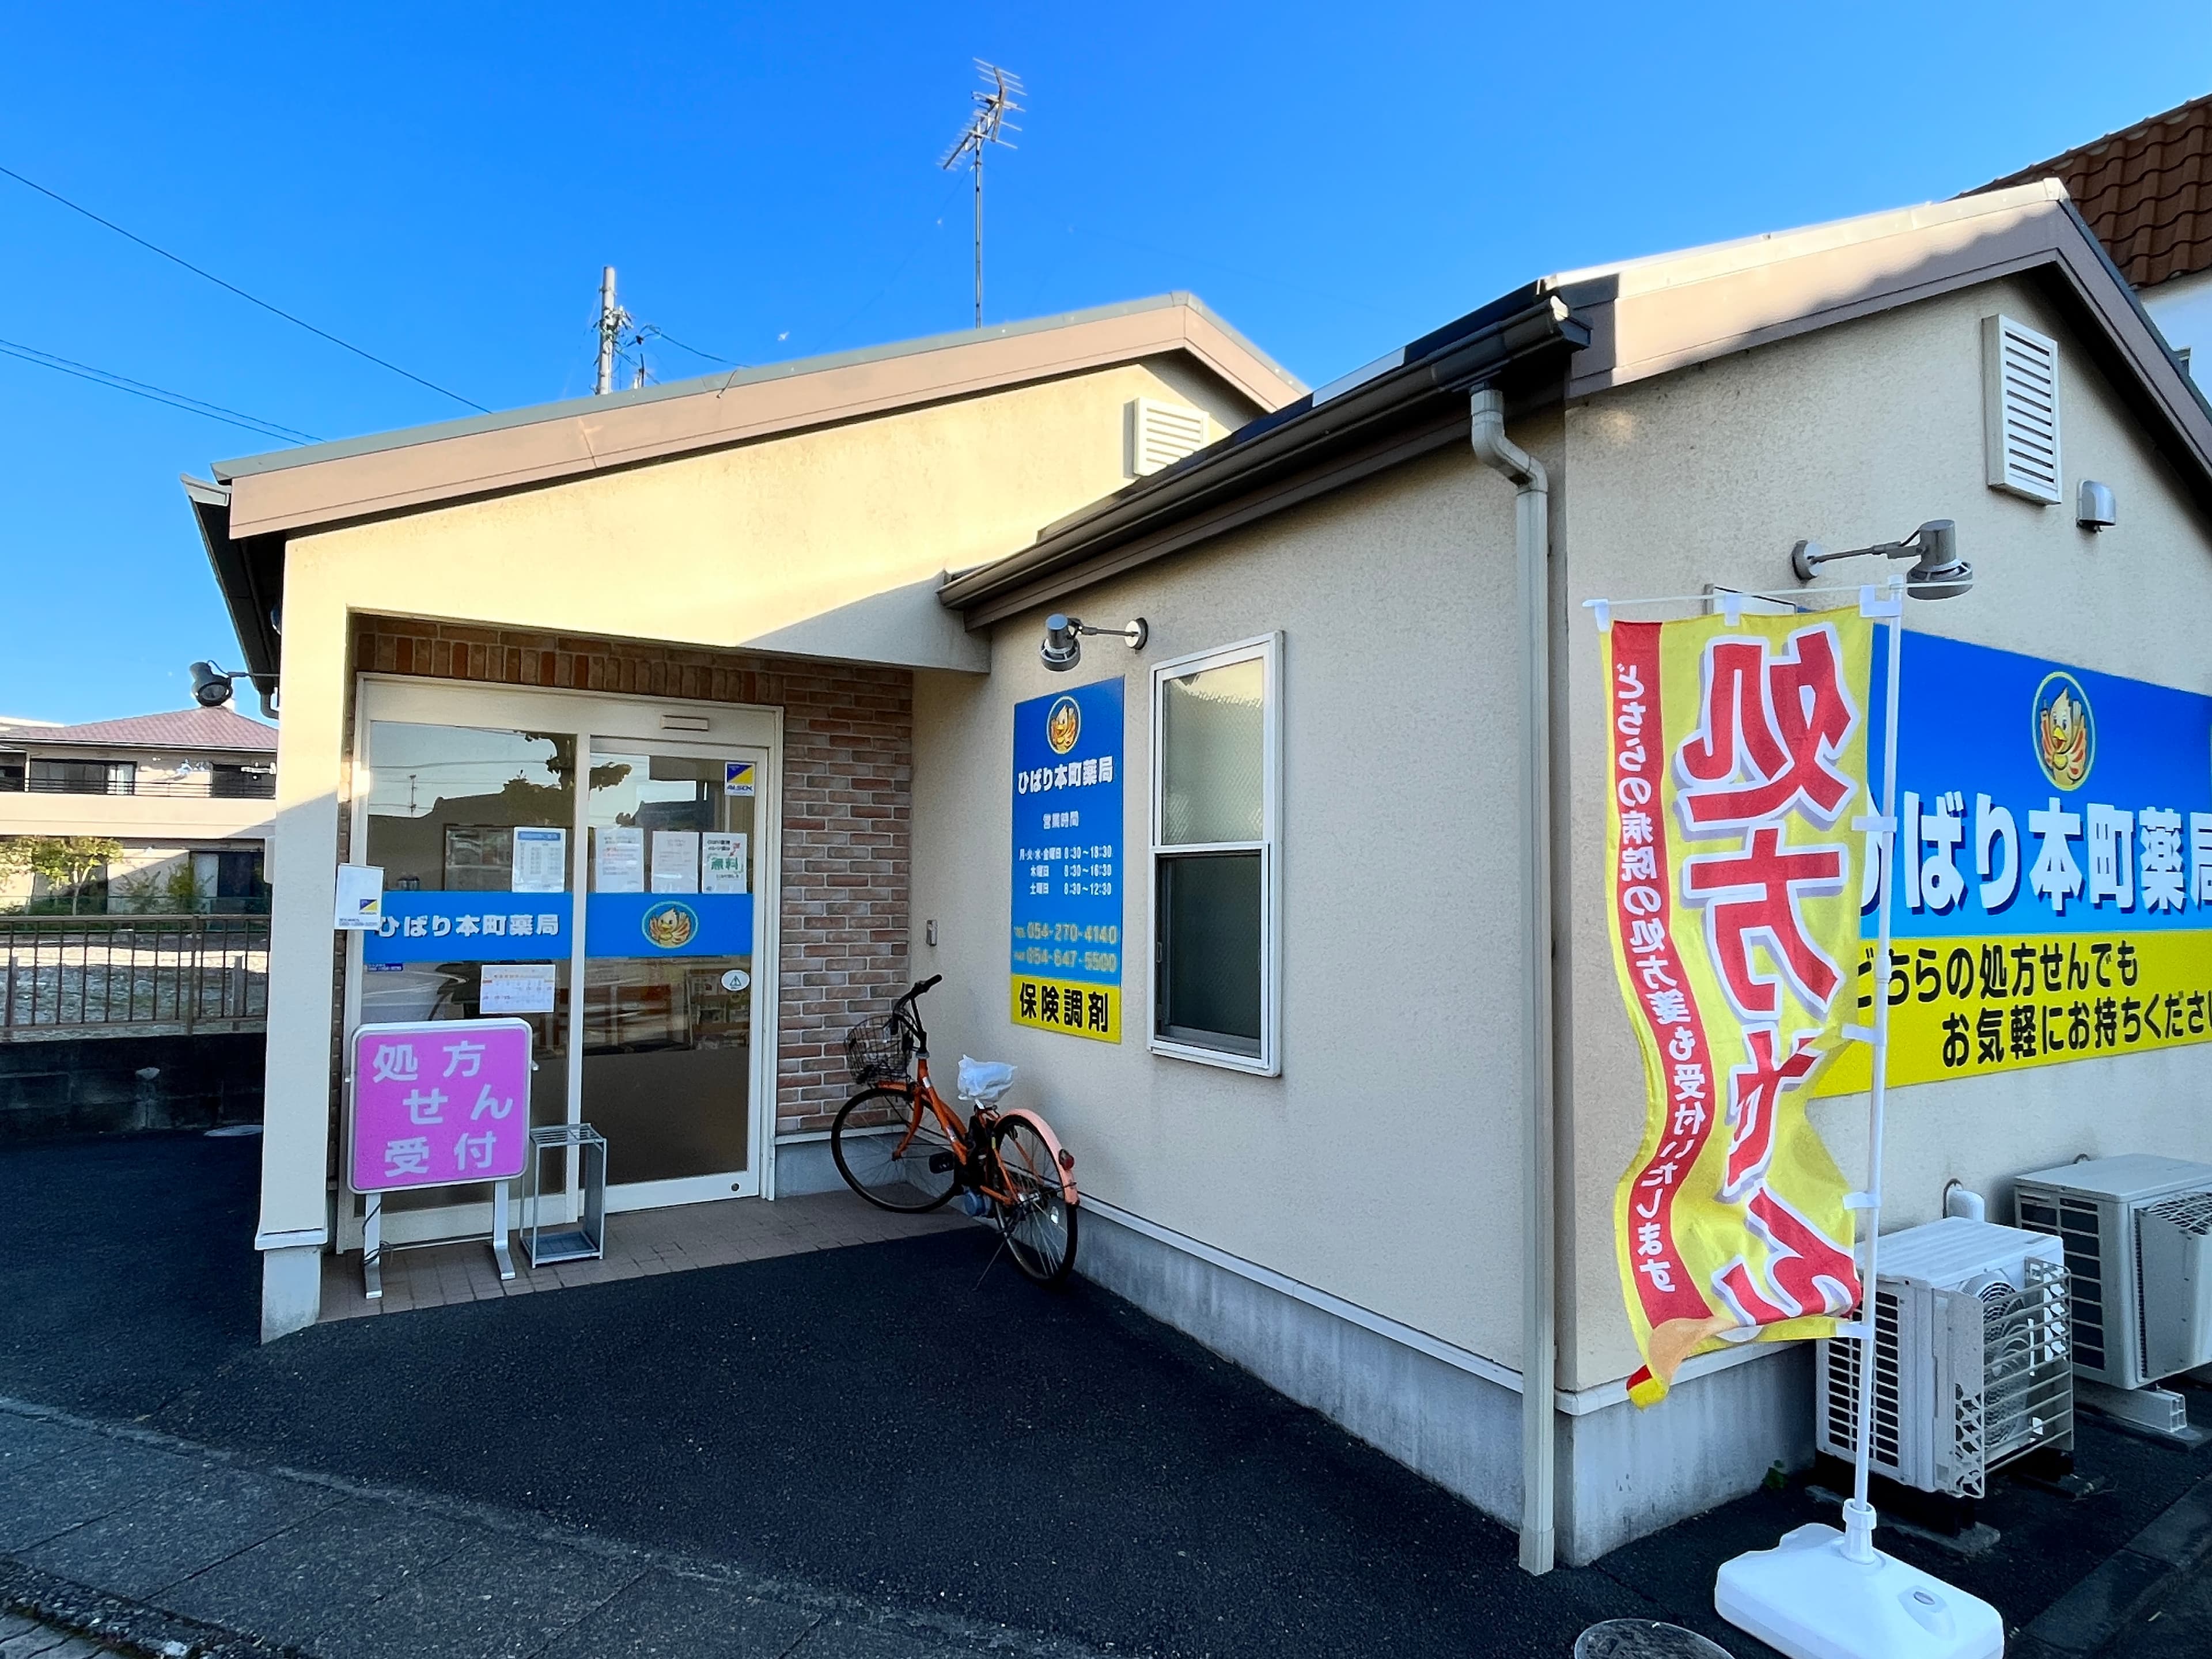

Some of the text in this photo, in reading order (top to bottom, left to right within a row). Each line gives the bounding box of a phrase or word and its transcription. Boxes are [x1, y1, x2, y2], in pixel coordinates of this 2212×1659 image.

[1018, 756, 1113, 794] ひばり本町薬局
[1043, 810, 1079, 830] 営業時間
[1029, 882, 1049, 895] 土曜日
[1030, 865, 1049, 877] 木曜日
[378, 914, 559, 937] ひばり本町薬局
[1020, 982, 1108, 1032] 保険調剤
[373, 1040, 486, 1084] 処方
[403, 1084, 513, 1125] せん
[384, 1131, 497, 1178] 受付
